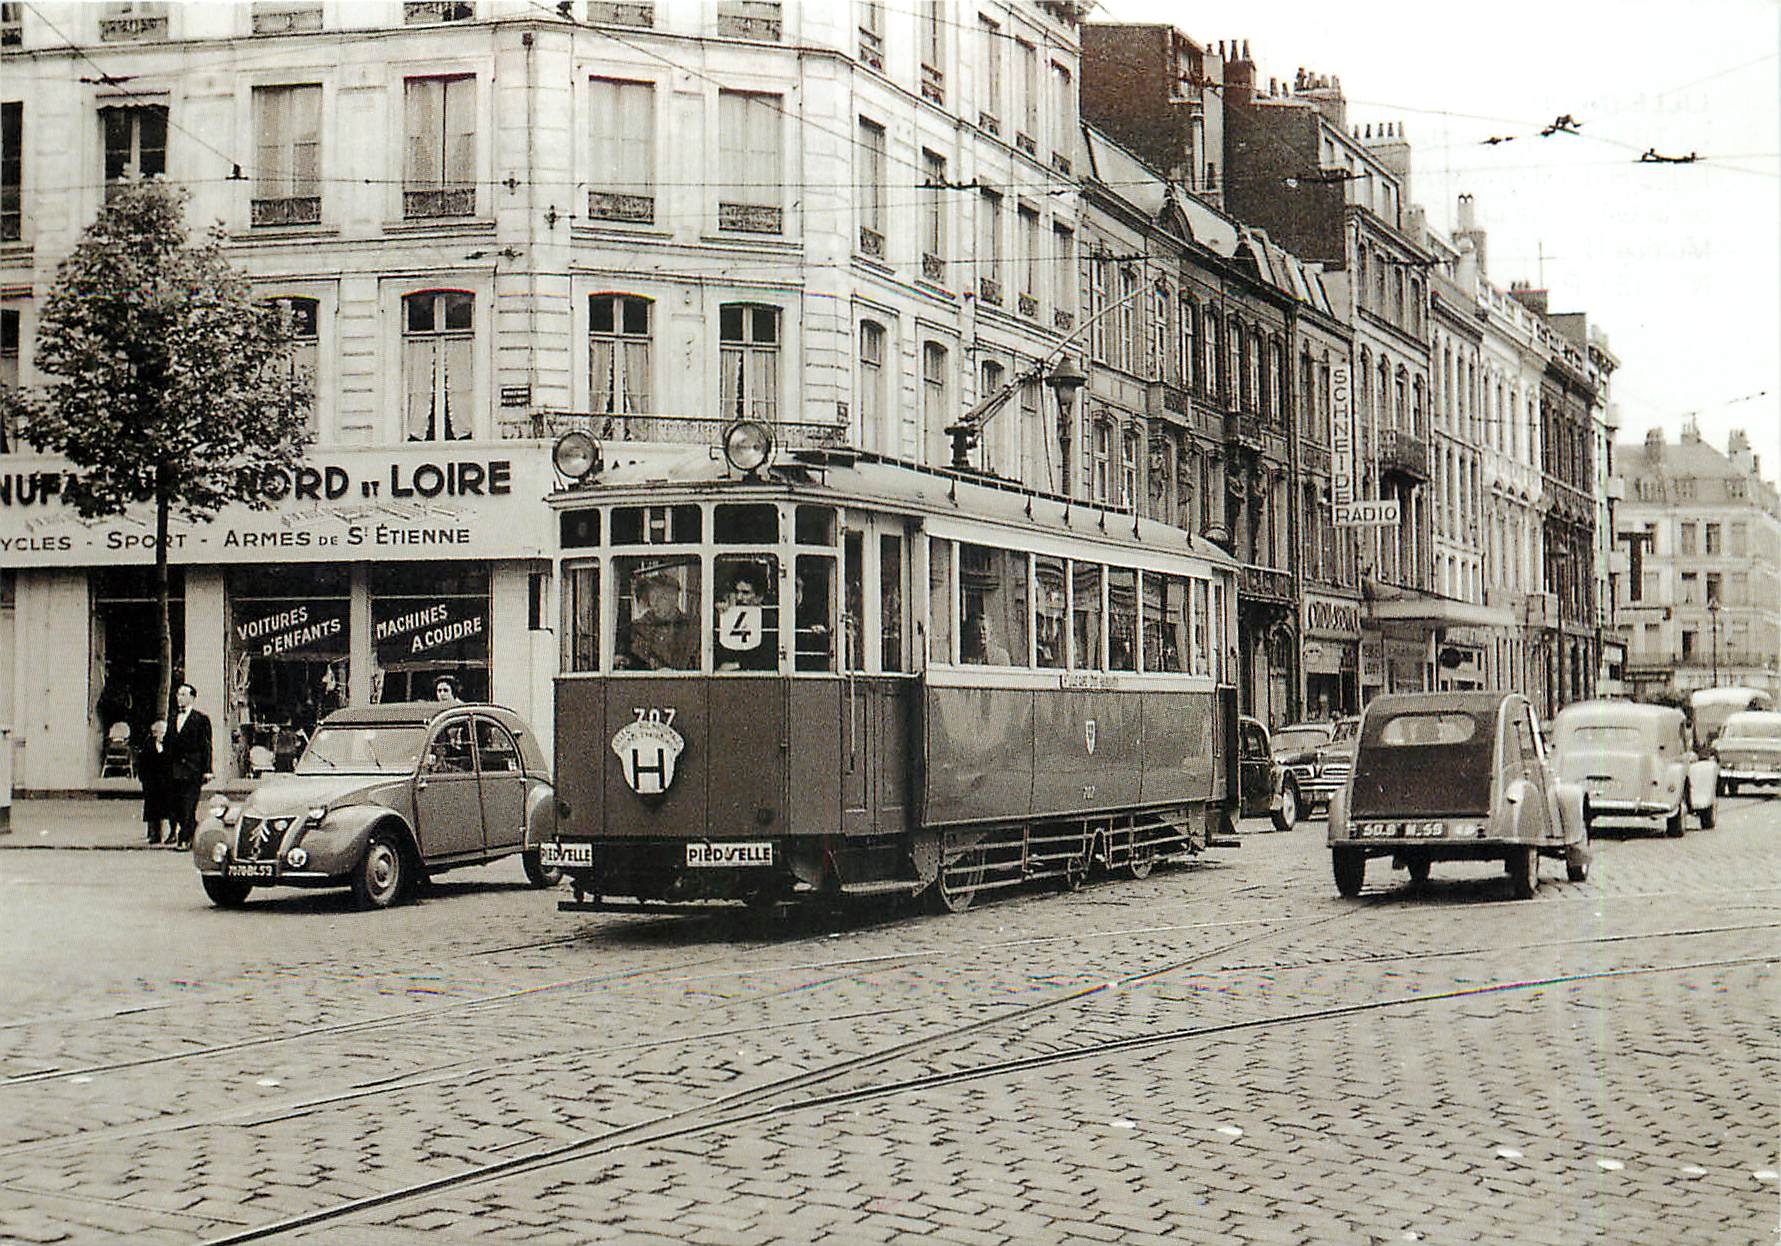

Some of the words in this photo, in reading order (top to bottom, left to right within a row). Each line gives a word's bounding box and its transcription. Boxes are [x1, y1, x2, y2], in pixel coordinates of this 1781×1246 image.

[391, 461, 511, 497] LOIRE
[1335, 505, 1398, 523] RADIO
[224, 530, 311, 548] ARMES
[236, 606, 309, 640] VOITURES
[262, 618, 341, 657] D'ENFANTS
[376, 604, 448, 640] MACHINES
[424, 616, 482, 647] COUDRE
[729, 611, 752, 643] 4
[632, 707, 677, 728] 707
[631, 748, 667, 790] H
